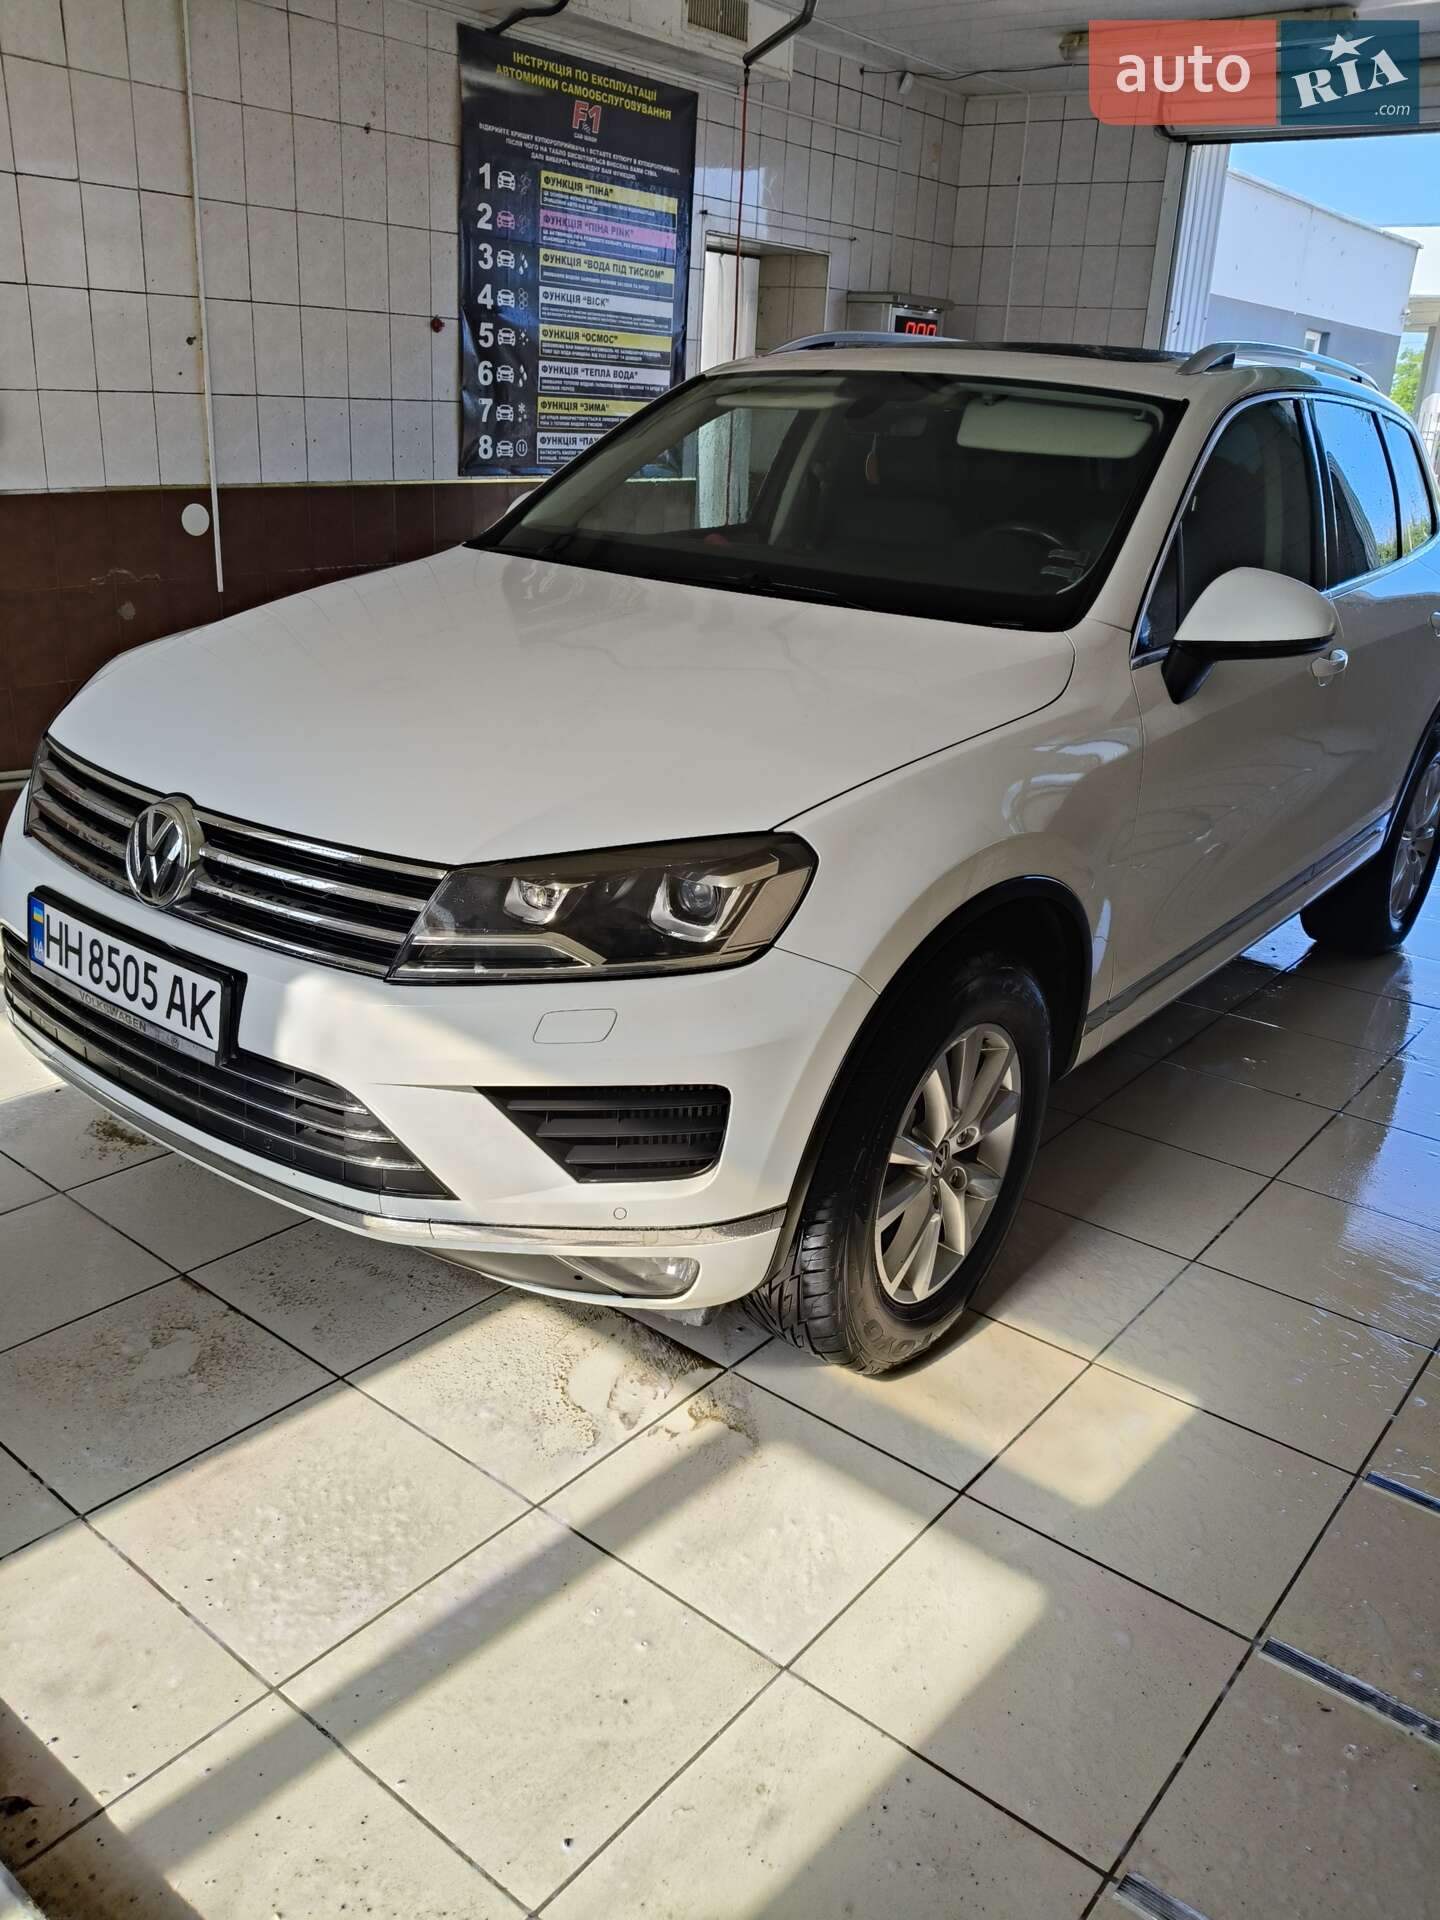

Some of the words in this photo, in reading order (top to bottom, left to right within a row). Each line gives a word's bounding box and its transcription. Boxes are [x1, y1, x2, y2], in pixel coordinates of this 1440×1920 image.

[513, 51, 572, 78] ІНСТРУКЦІЯ
[575, 69, 589, 82] ПО
[591, 74, 657, 101] ЕКСПЛУАТАЦІЇ
[496, 64, 559, 89] АВТОМИЙКИ
[561, 81, 672, 120] САМООБСЛУГОВУВАННЯ
[572, 100, 602, 134] F1
[479, 163, 491, 189] 1
[544, 176, 583, 192] ФУНКЦІЯ
[477, 202, 492, 229] 2
[544, 214, 582, 229] ФУНКЦІЯ
[478, 243, 493, 269] 3
[542, 253, 581, 267] ФУНКЦІЯ
[612, 264, 627, 275] ПІД
[477, 284, 493, 309] 4
[542, 291, 581, 304] ФУНКЦІЯ
[478, 322, 494, 348] 5
[541, 329, 580, 341] ФУНКЦІЯ
[478, 361, 493, 386] 6
[541, 365, 579, 376] ФУНКЦІЯ
[479, 399, 493, 422] 7
[540, 400, 578, 412] ФУНКЦІЯ
[478, 435, 493, 460] 8
[540, 436, 577, 446] ФУНКЦІЯ
[33, 936, 45, 954] UA
[46, 914, 83, 976] HH
[89, 939, 158, 1011] 8505
[166, 975, 215, 1040] AK
[79, 991, 146, 1032] VOLKSWAGEN
